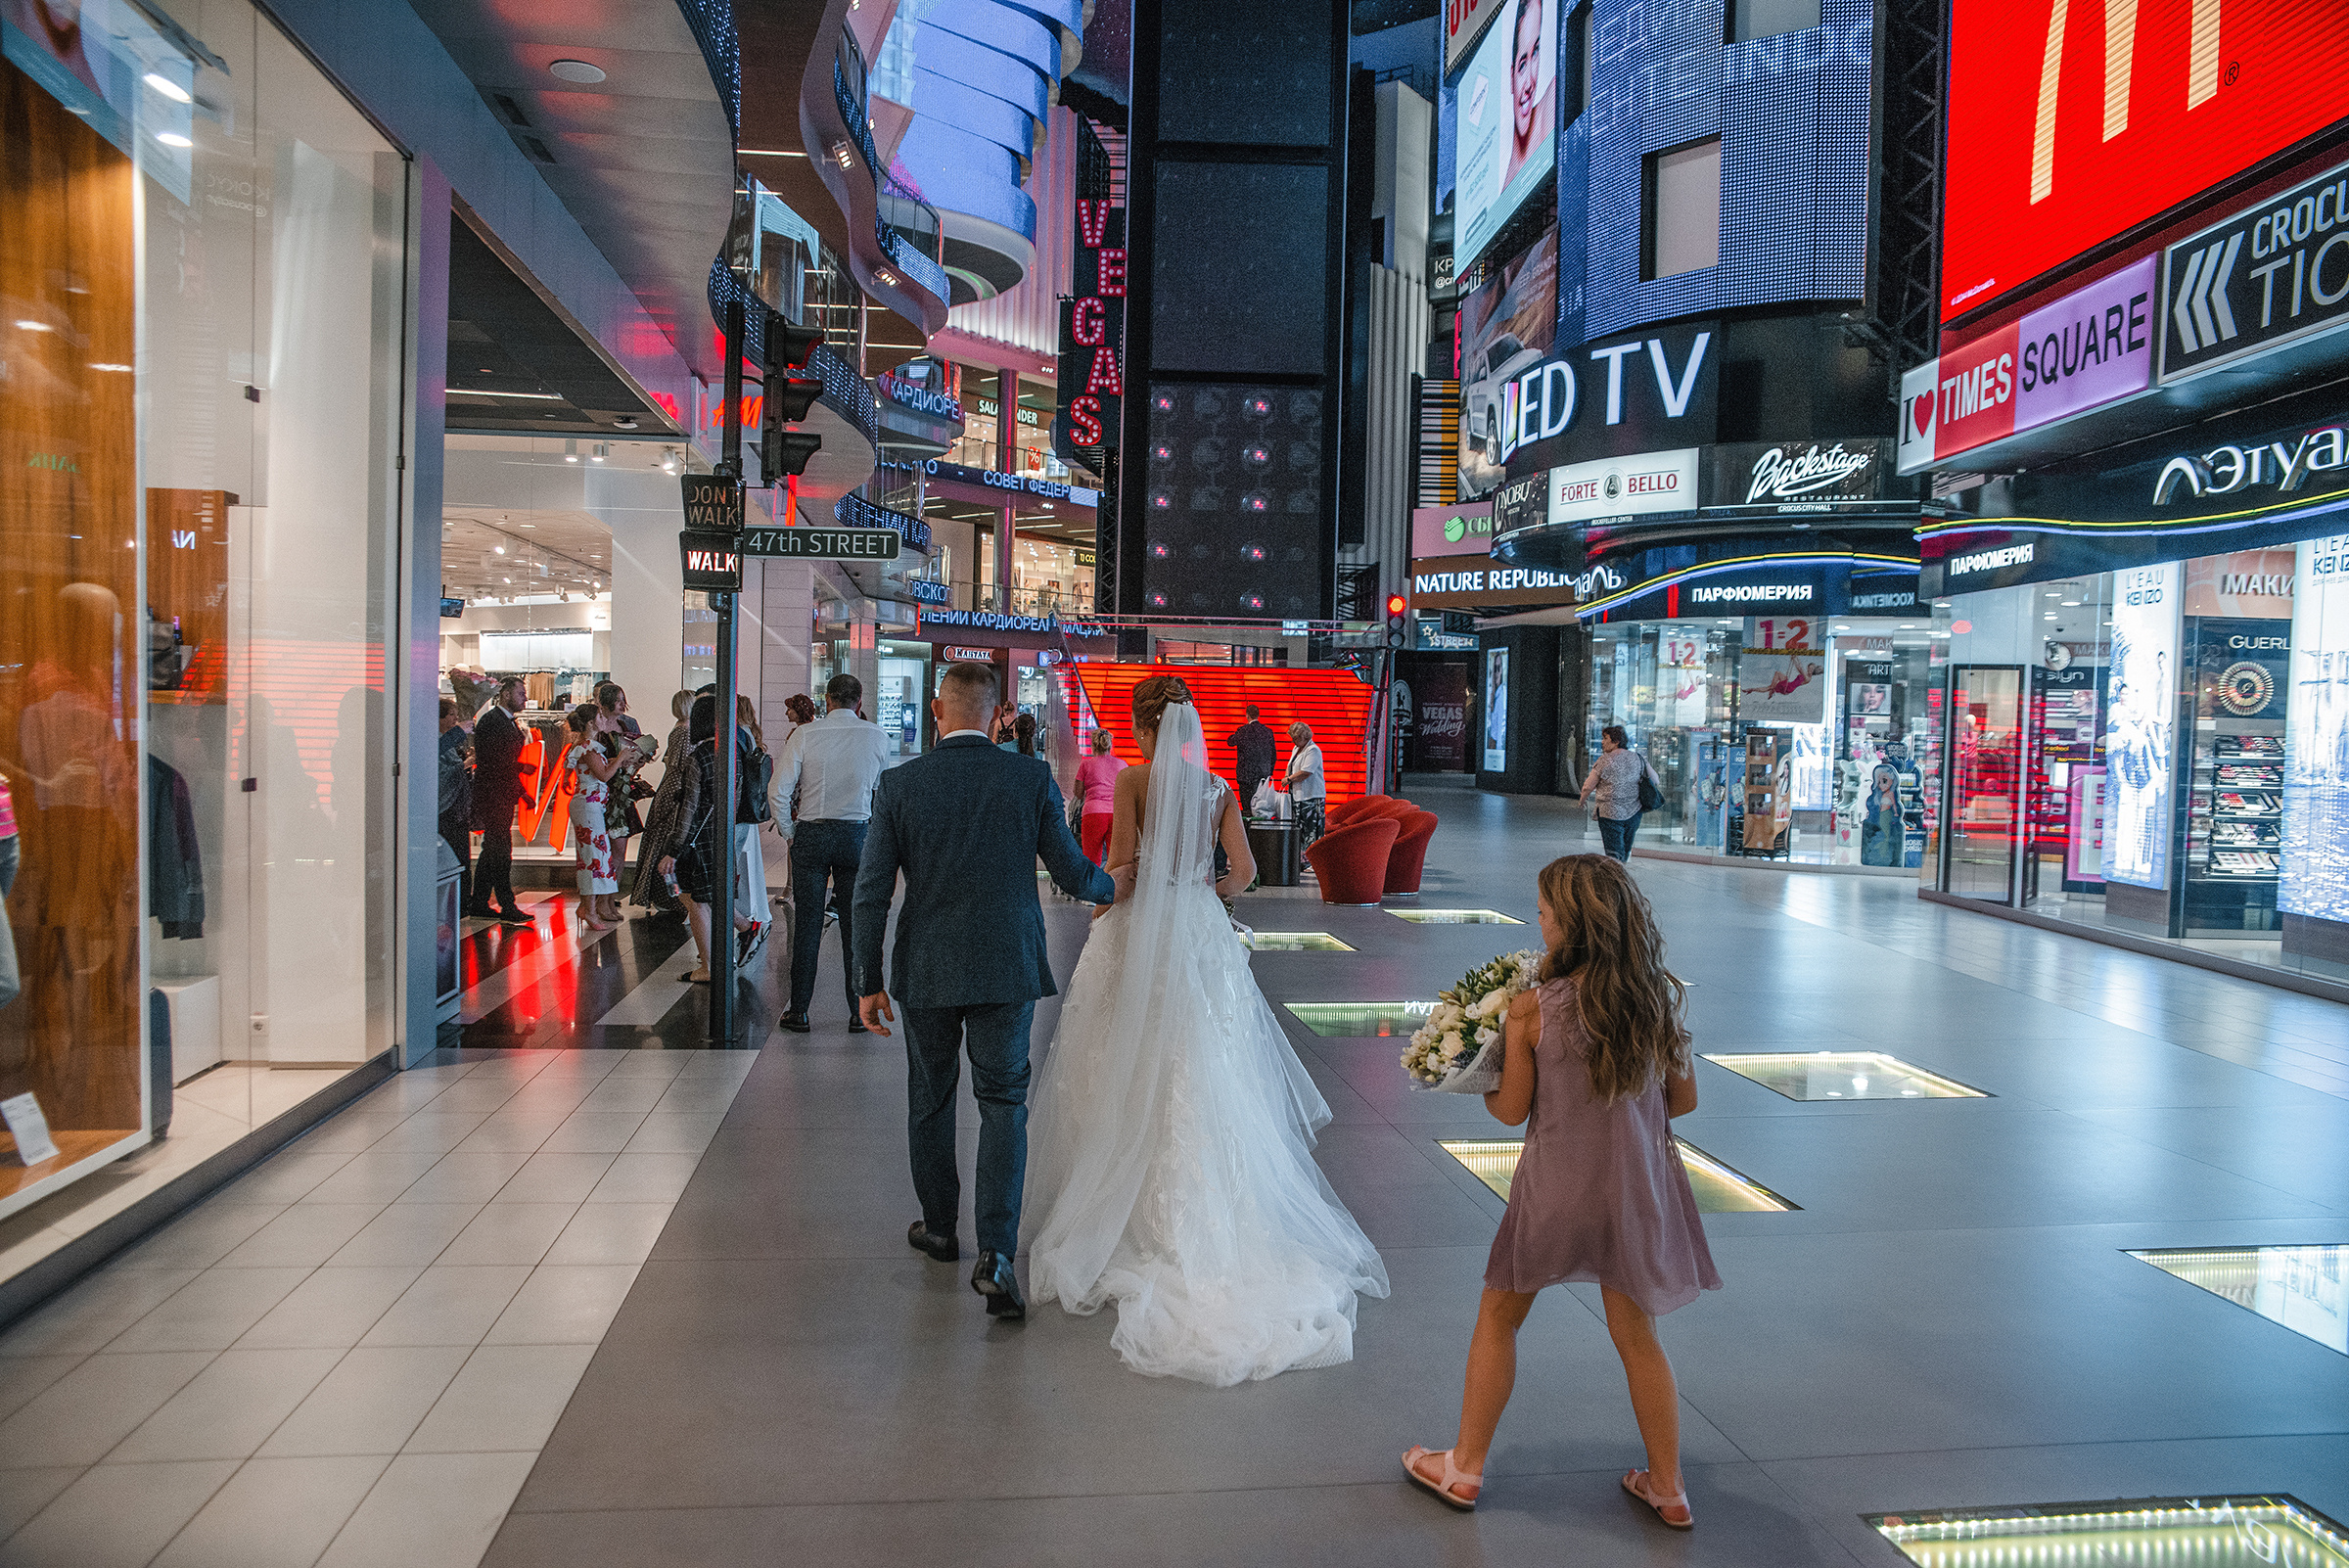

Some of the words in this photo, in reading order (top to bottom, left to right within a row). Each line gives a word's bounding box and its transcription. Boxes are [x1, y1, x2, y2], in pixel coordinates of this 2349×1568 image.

[1070, 199, 1127, 445] VEGAS
[1941, 353, 2012, 425] TIMES
[2022, 293, 2148, 392] SQUARE
[1500, 360, 1576, 465] LED
[1590, 332, 1711, 426] TV
[984, 470, 1026, 490] СОВЕТ
[1746, 443, 1869, 504] Backstage
[1561, 483, 1597, 502] FORTE
[1629, 474, 1678, 492] BELLO
[688, 506, 737, 526] WALK
[749, 531, 801, 553] 47th
[809, 533, 893, 555] STREET
[687, 550, 736, 573] WALK
[1951, 543, 2034, 576] ПАРФЮМЕРИЯ
[1415, 571, 1484, 594] NATURE
[2126, 569, 2165, 589] L'EAU
[1692, 584, 1813, 603] ПАРФЮМЕРИЯ
[2126, 588, 2164, 606] KENZO
[2229, 635, 2292, 650] GUERL
[1422, 706, 1464, 719] VEGAS
[1419, 716, 1466, 738] Wedding
